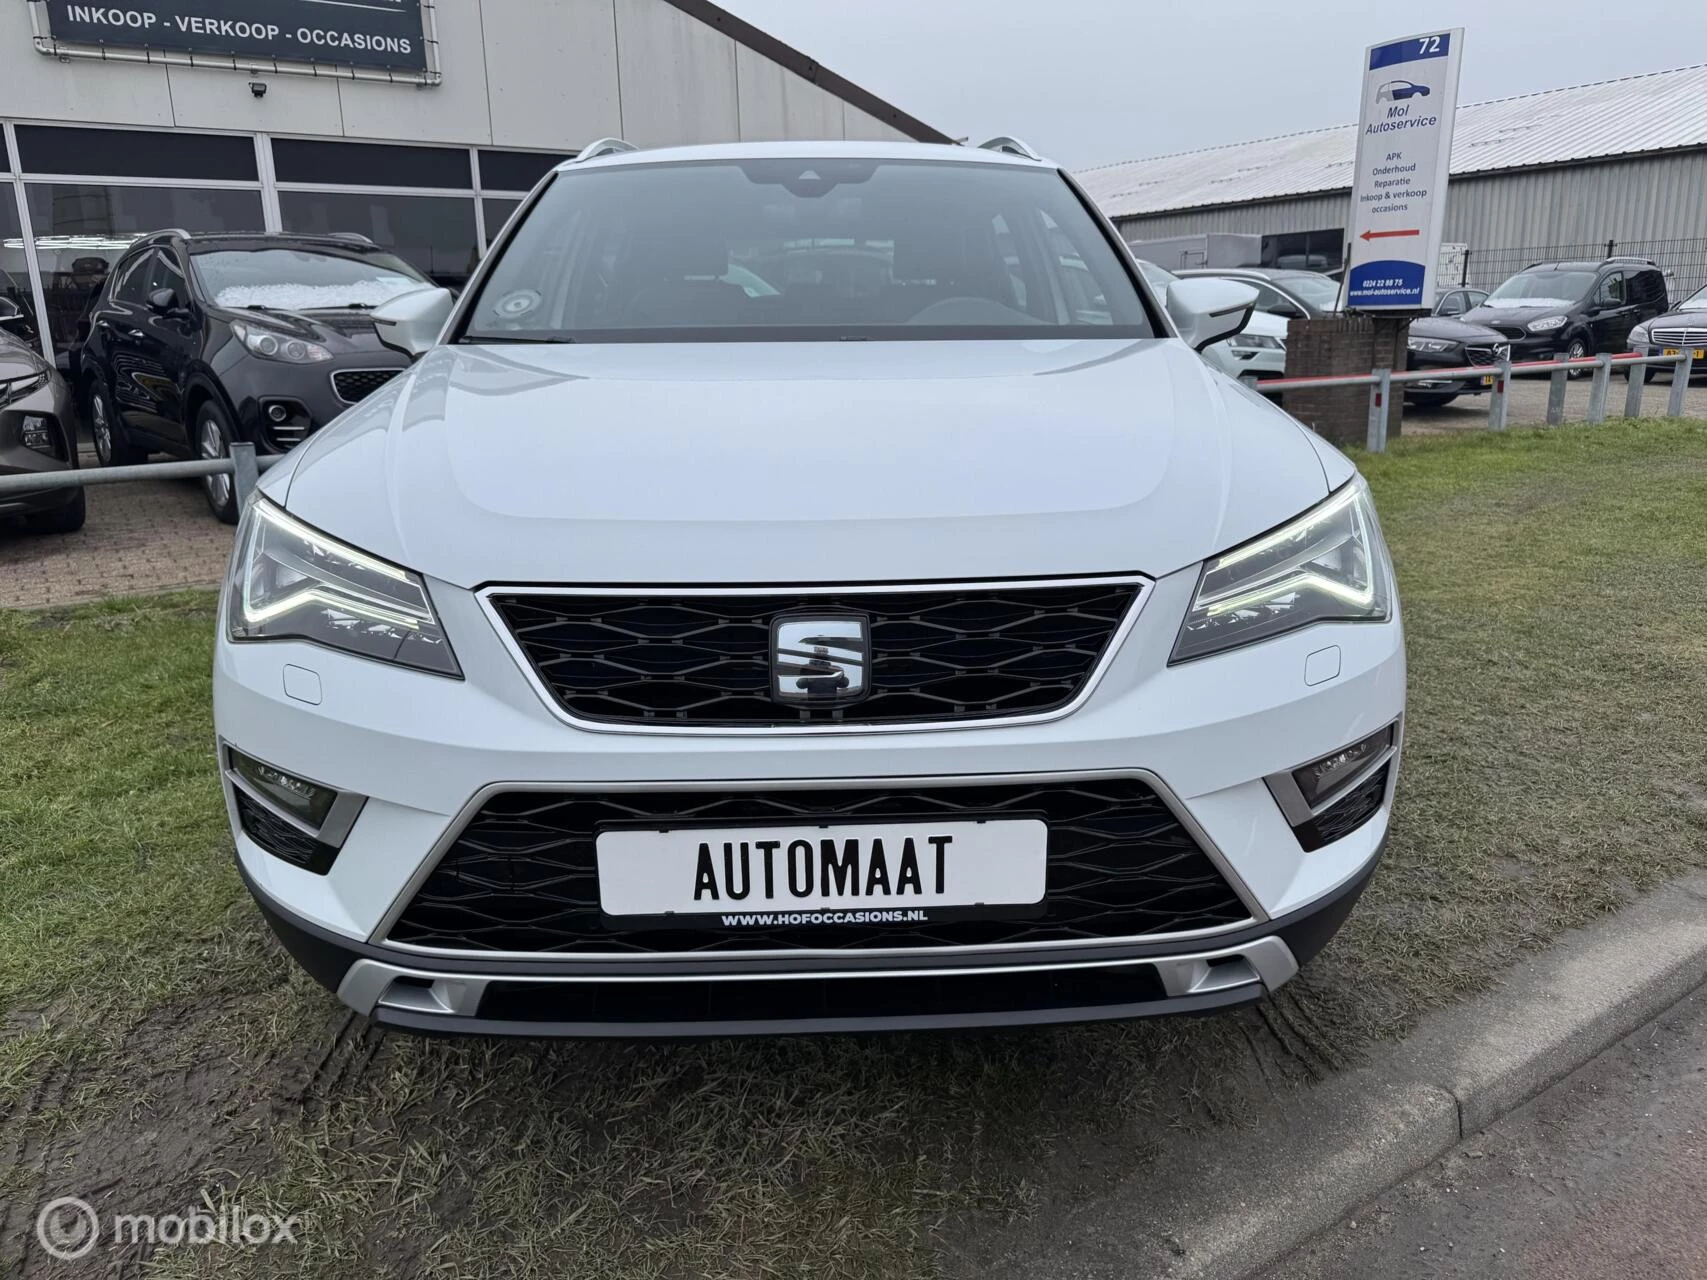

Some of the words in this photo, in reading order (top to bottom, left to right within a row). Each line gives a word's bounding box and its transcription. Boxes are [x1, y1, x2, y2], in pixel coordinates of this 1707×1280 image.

[67, 5, 156, 28] INKOOP
[175, 15, 279, 40] VERKOOP
[296, 28, 412, 54] OCCASIONS
[1419, 35, 1441, 54] 72
[1387, 104, 1410, 119] Mol
[1365, 115, 1437, 135] Autoservice
[1386, 152, 1402, 161] APK
[1372, 163, 1416, 176] Onderhoud
[1374, 177, 1411, 189] Reparatie
[1384, 191, 1391, 200] &
[1393, 190, 1427, 199] verkoop
[1371, 203, 1408, 214] occasions
[1350, 286, 1420, 297] www.mol-autoservice.nl
[693, 835, 953, 901] AUTOMAAT
[721, 910, 928, 926] WWW.HOFOCCASIONS.NL
